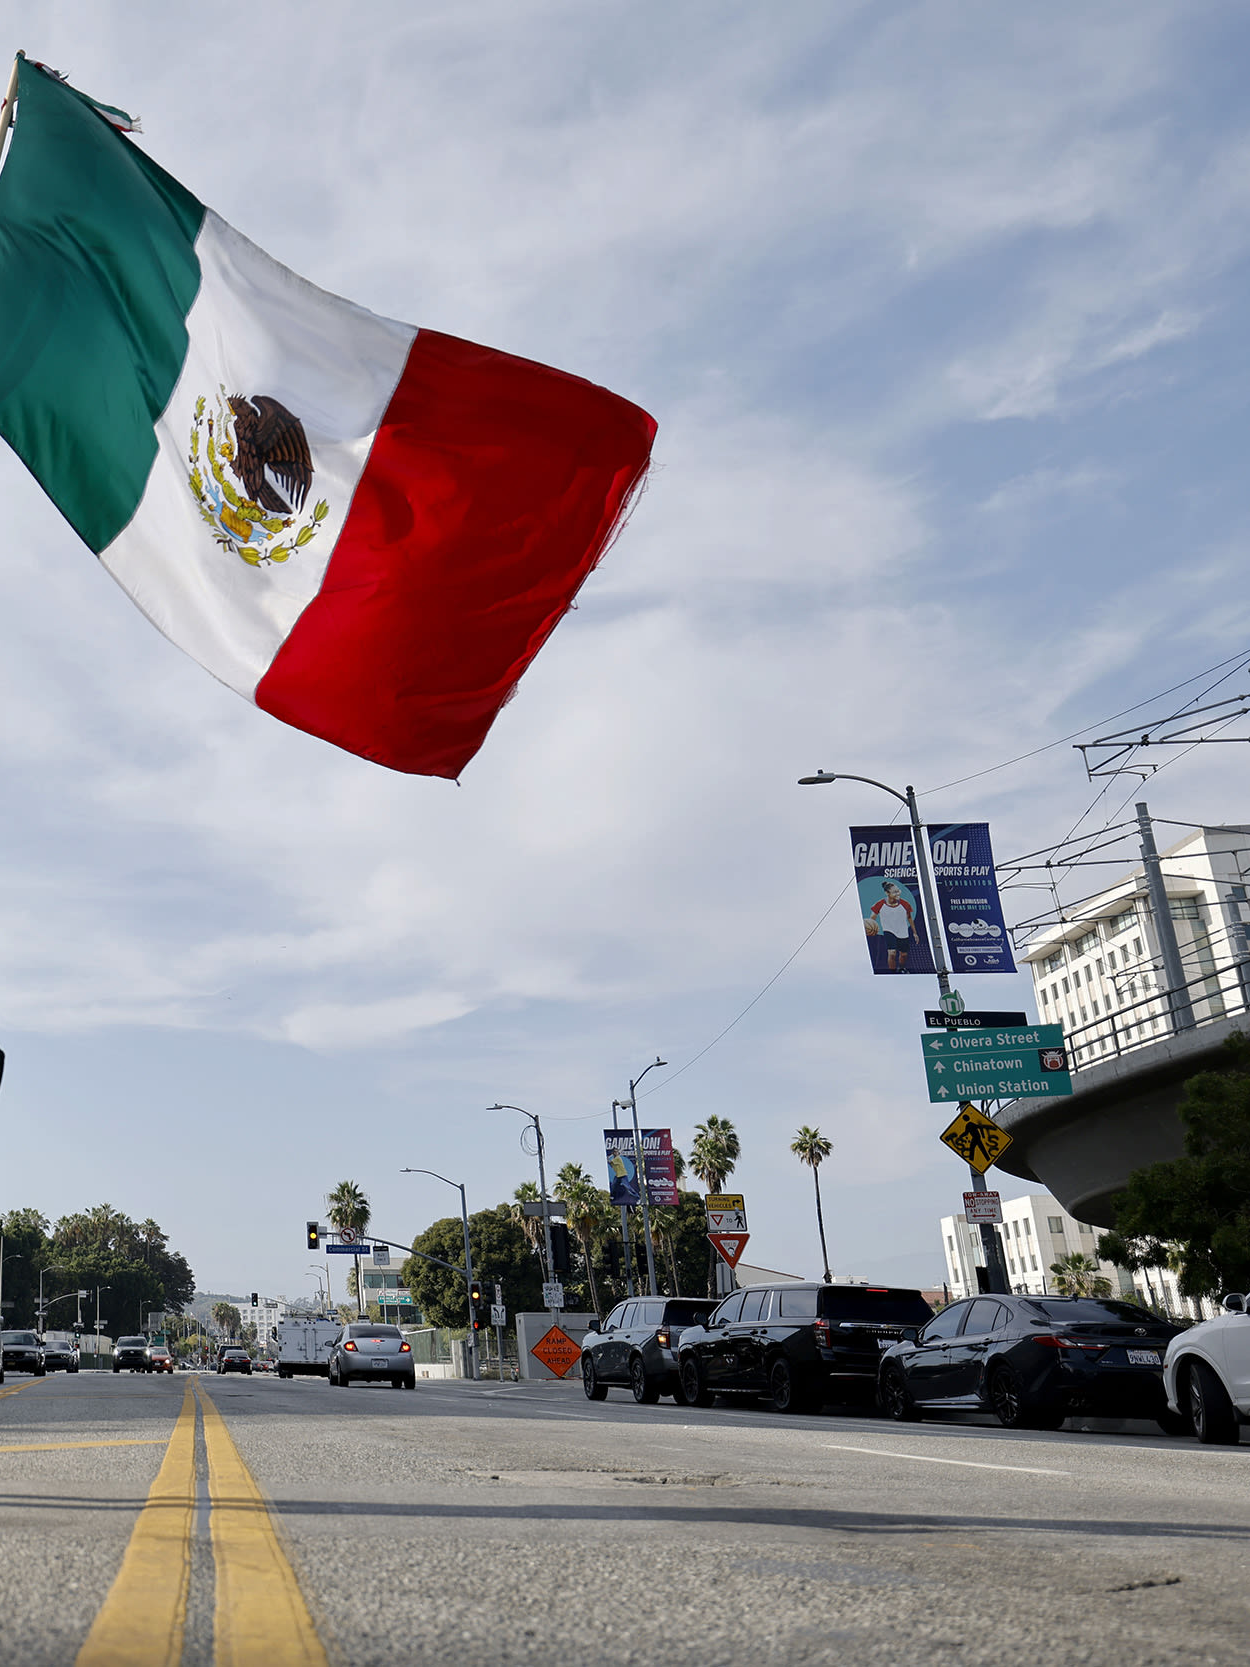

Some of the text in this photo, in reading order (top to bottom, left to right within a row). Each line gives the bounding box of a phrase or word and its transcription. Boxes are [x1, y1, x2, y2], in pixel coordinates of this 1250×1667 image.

[854, 839, 969, 868] GAME ON!
[934, 866, 962, 877] SPORTS
[963, 866, 970, 876] &
[970, 865, 990, 876] PLAY
[950, 1031, 1040, 1049] Olvera Street
[953, 1057, 1023, 1073] Chinatown
[956, 1079, 1050, 1096] Union Station
[605, 1137, 661, 1150] GAME ON!
[965, 1198, 975, 1207] NO
